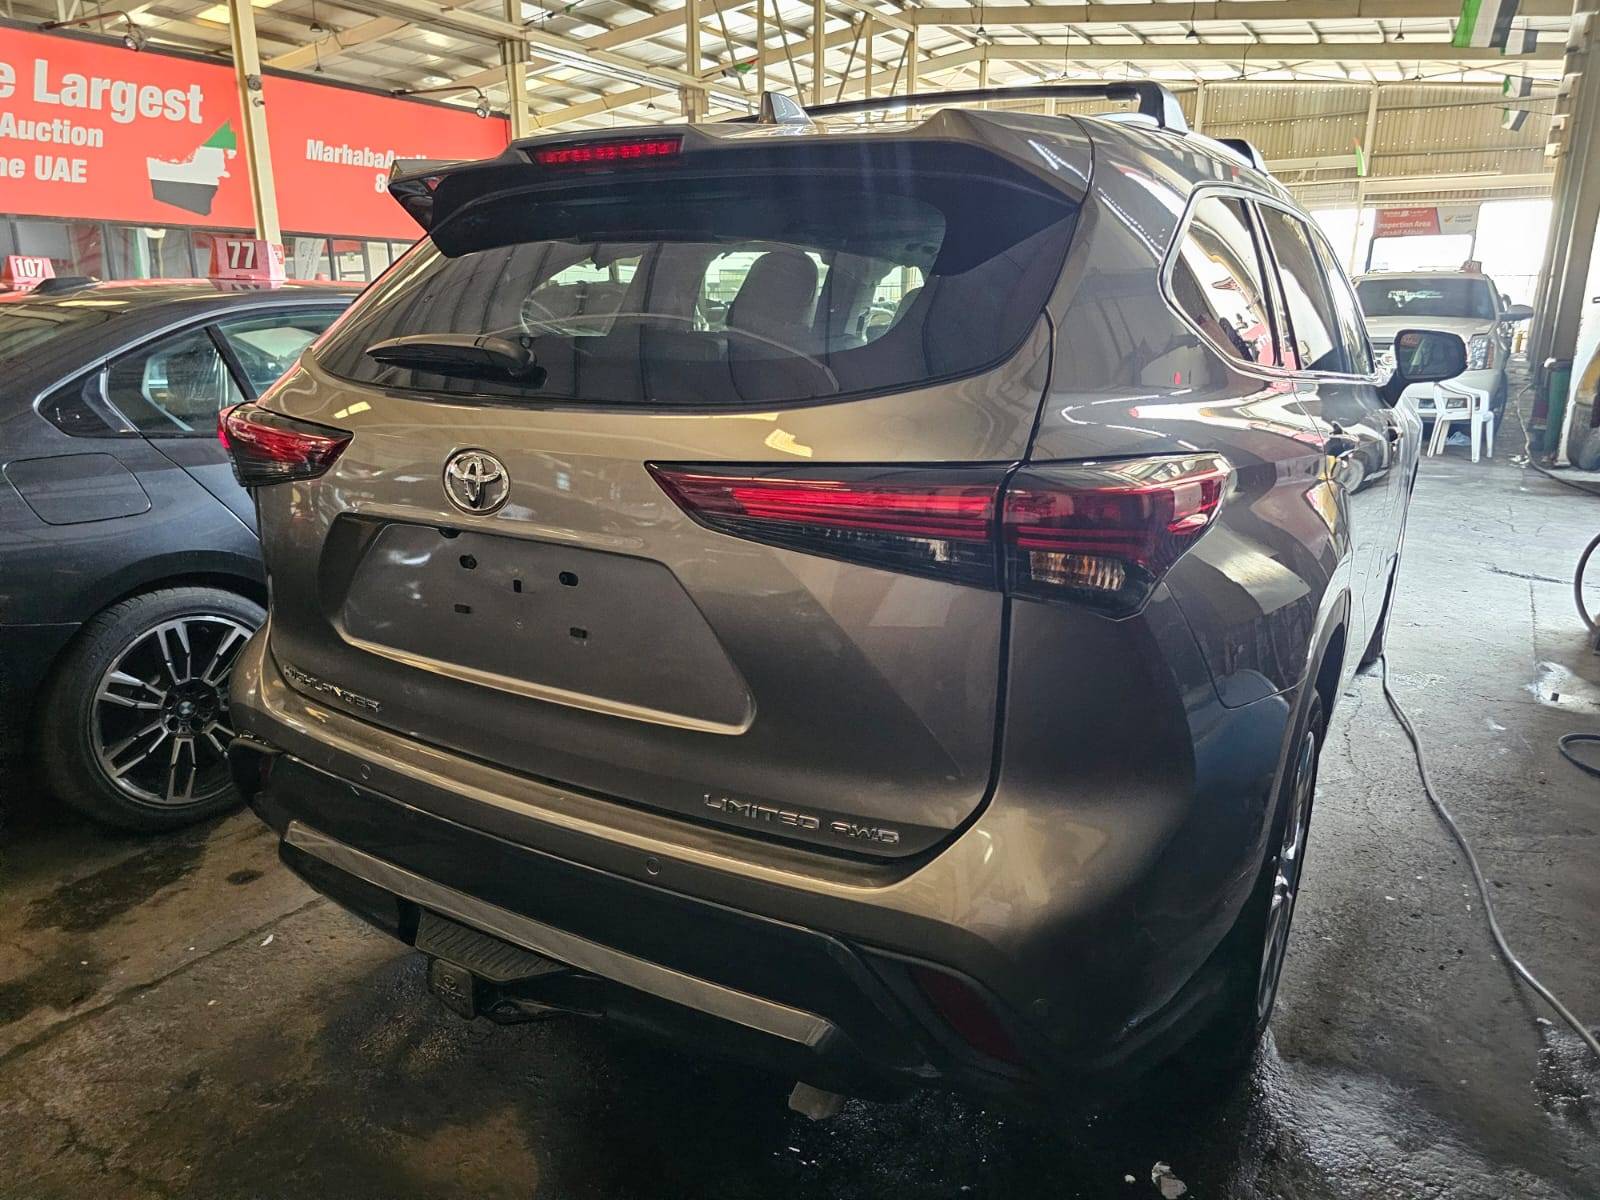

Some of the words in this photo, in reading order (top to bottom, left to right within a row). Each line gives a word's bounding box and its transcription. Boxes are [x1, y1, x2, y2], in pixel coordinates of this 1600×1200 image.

[34, 58, 203, 124] Largest
[0, 112, 103, 147] Auction
[35, 155, 87, 183] UAE
[15, 257, 44, 277] 107
[227, 241, 255, 269] 77
[703, 794, 820, 831] LIMITED
[830, 821, 900, 846] AWD
